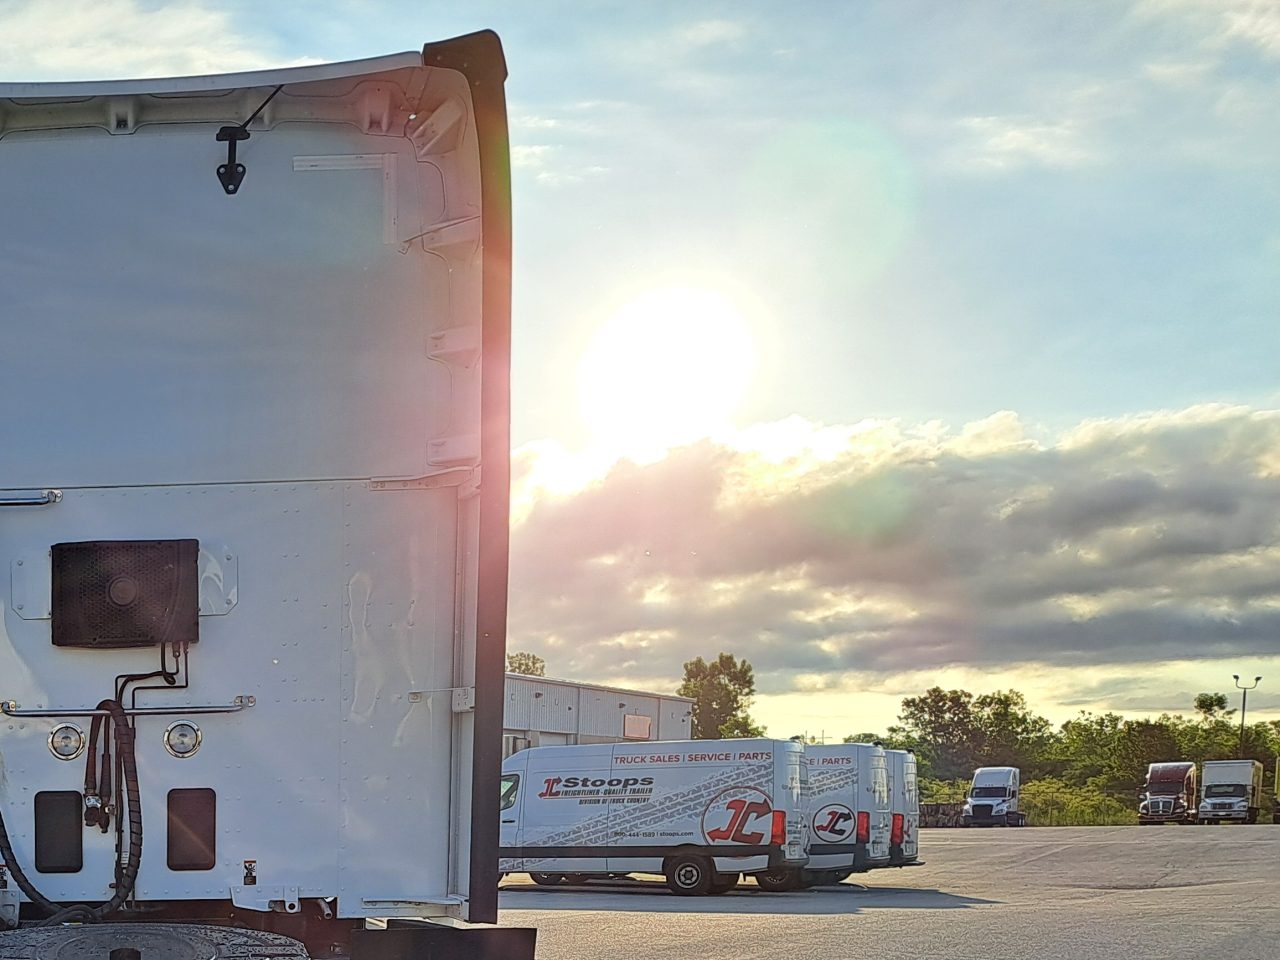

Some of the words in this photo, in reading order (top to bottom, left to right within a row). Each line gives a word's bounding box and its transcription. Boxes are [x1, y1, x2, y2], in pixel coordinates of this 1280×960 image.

[614, 755, 647, 764] TRUCK
[649, 754, 681, 763] SALES
[687, 752, 731, 762] SERVICE
[738, 751, 772, 761] PARTS
[822, 757, 852, 765] PARTS
[562, 777, 654, 788] Stoops
